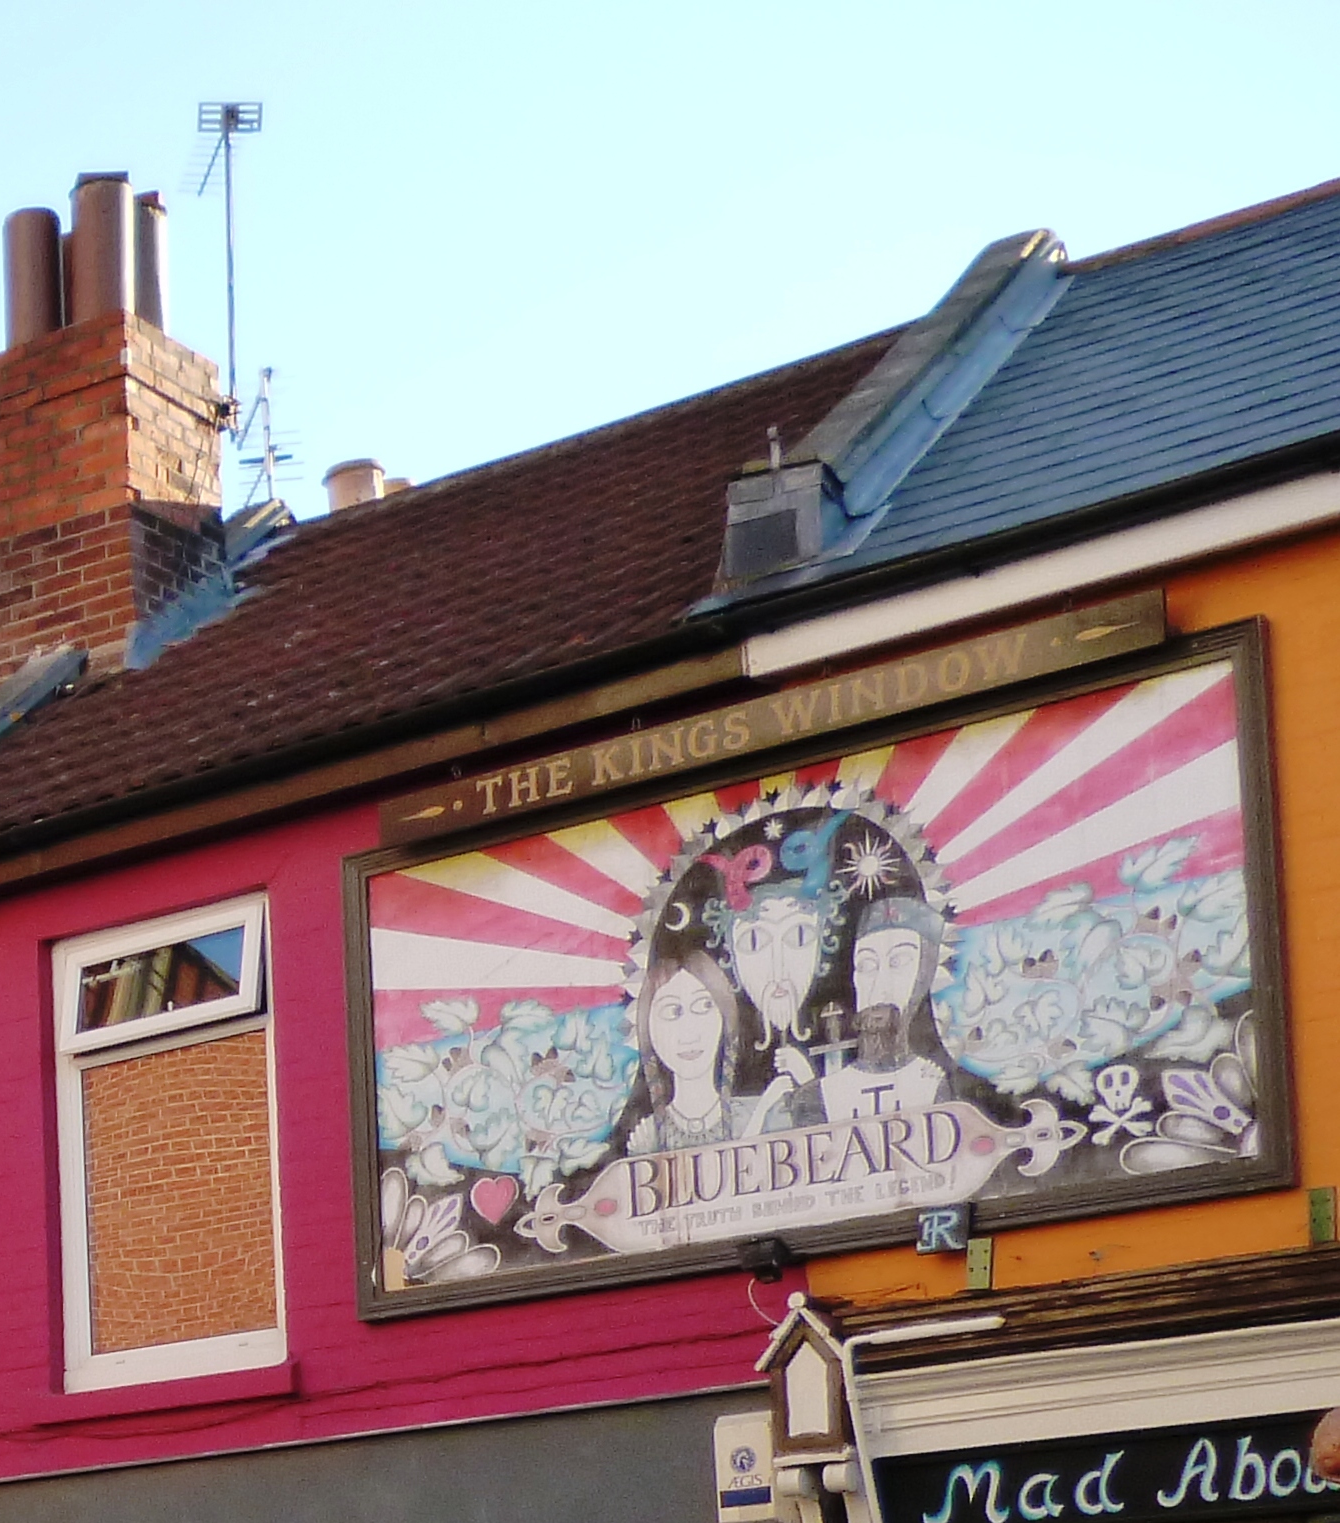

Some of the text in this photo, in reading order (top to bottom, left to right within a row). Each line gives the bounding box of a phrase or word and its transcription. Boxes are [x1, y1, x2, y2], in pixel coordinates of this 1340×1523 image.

[476, 633, 1027, 816] THE KINGS WINDOW
[624, 1110, 963, 1220] BLUEBEARD
[638, 1216, 677, 1237] THE
[684, 1206, 742, 1230] TRUTH
[825, 1184, 864, 1206] THE
